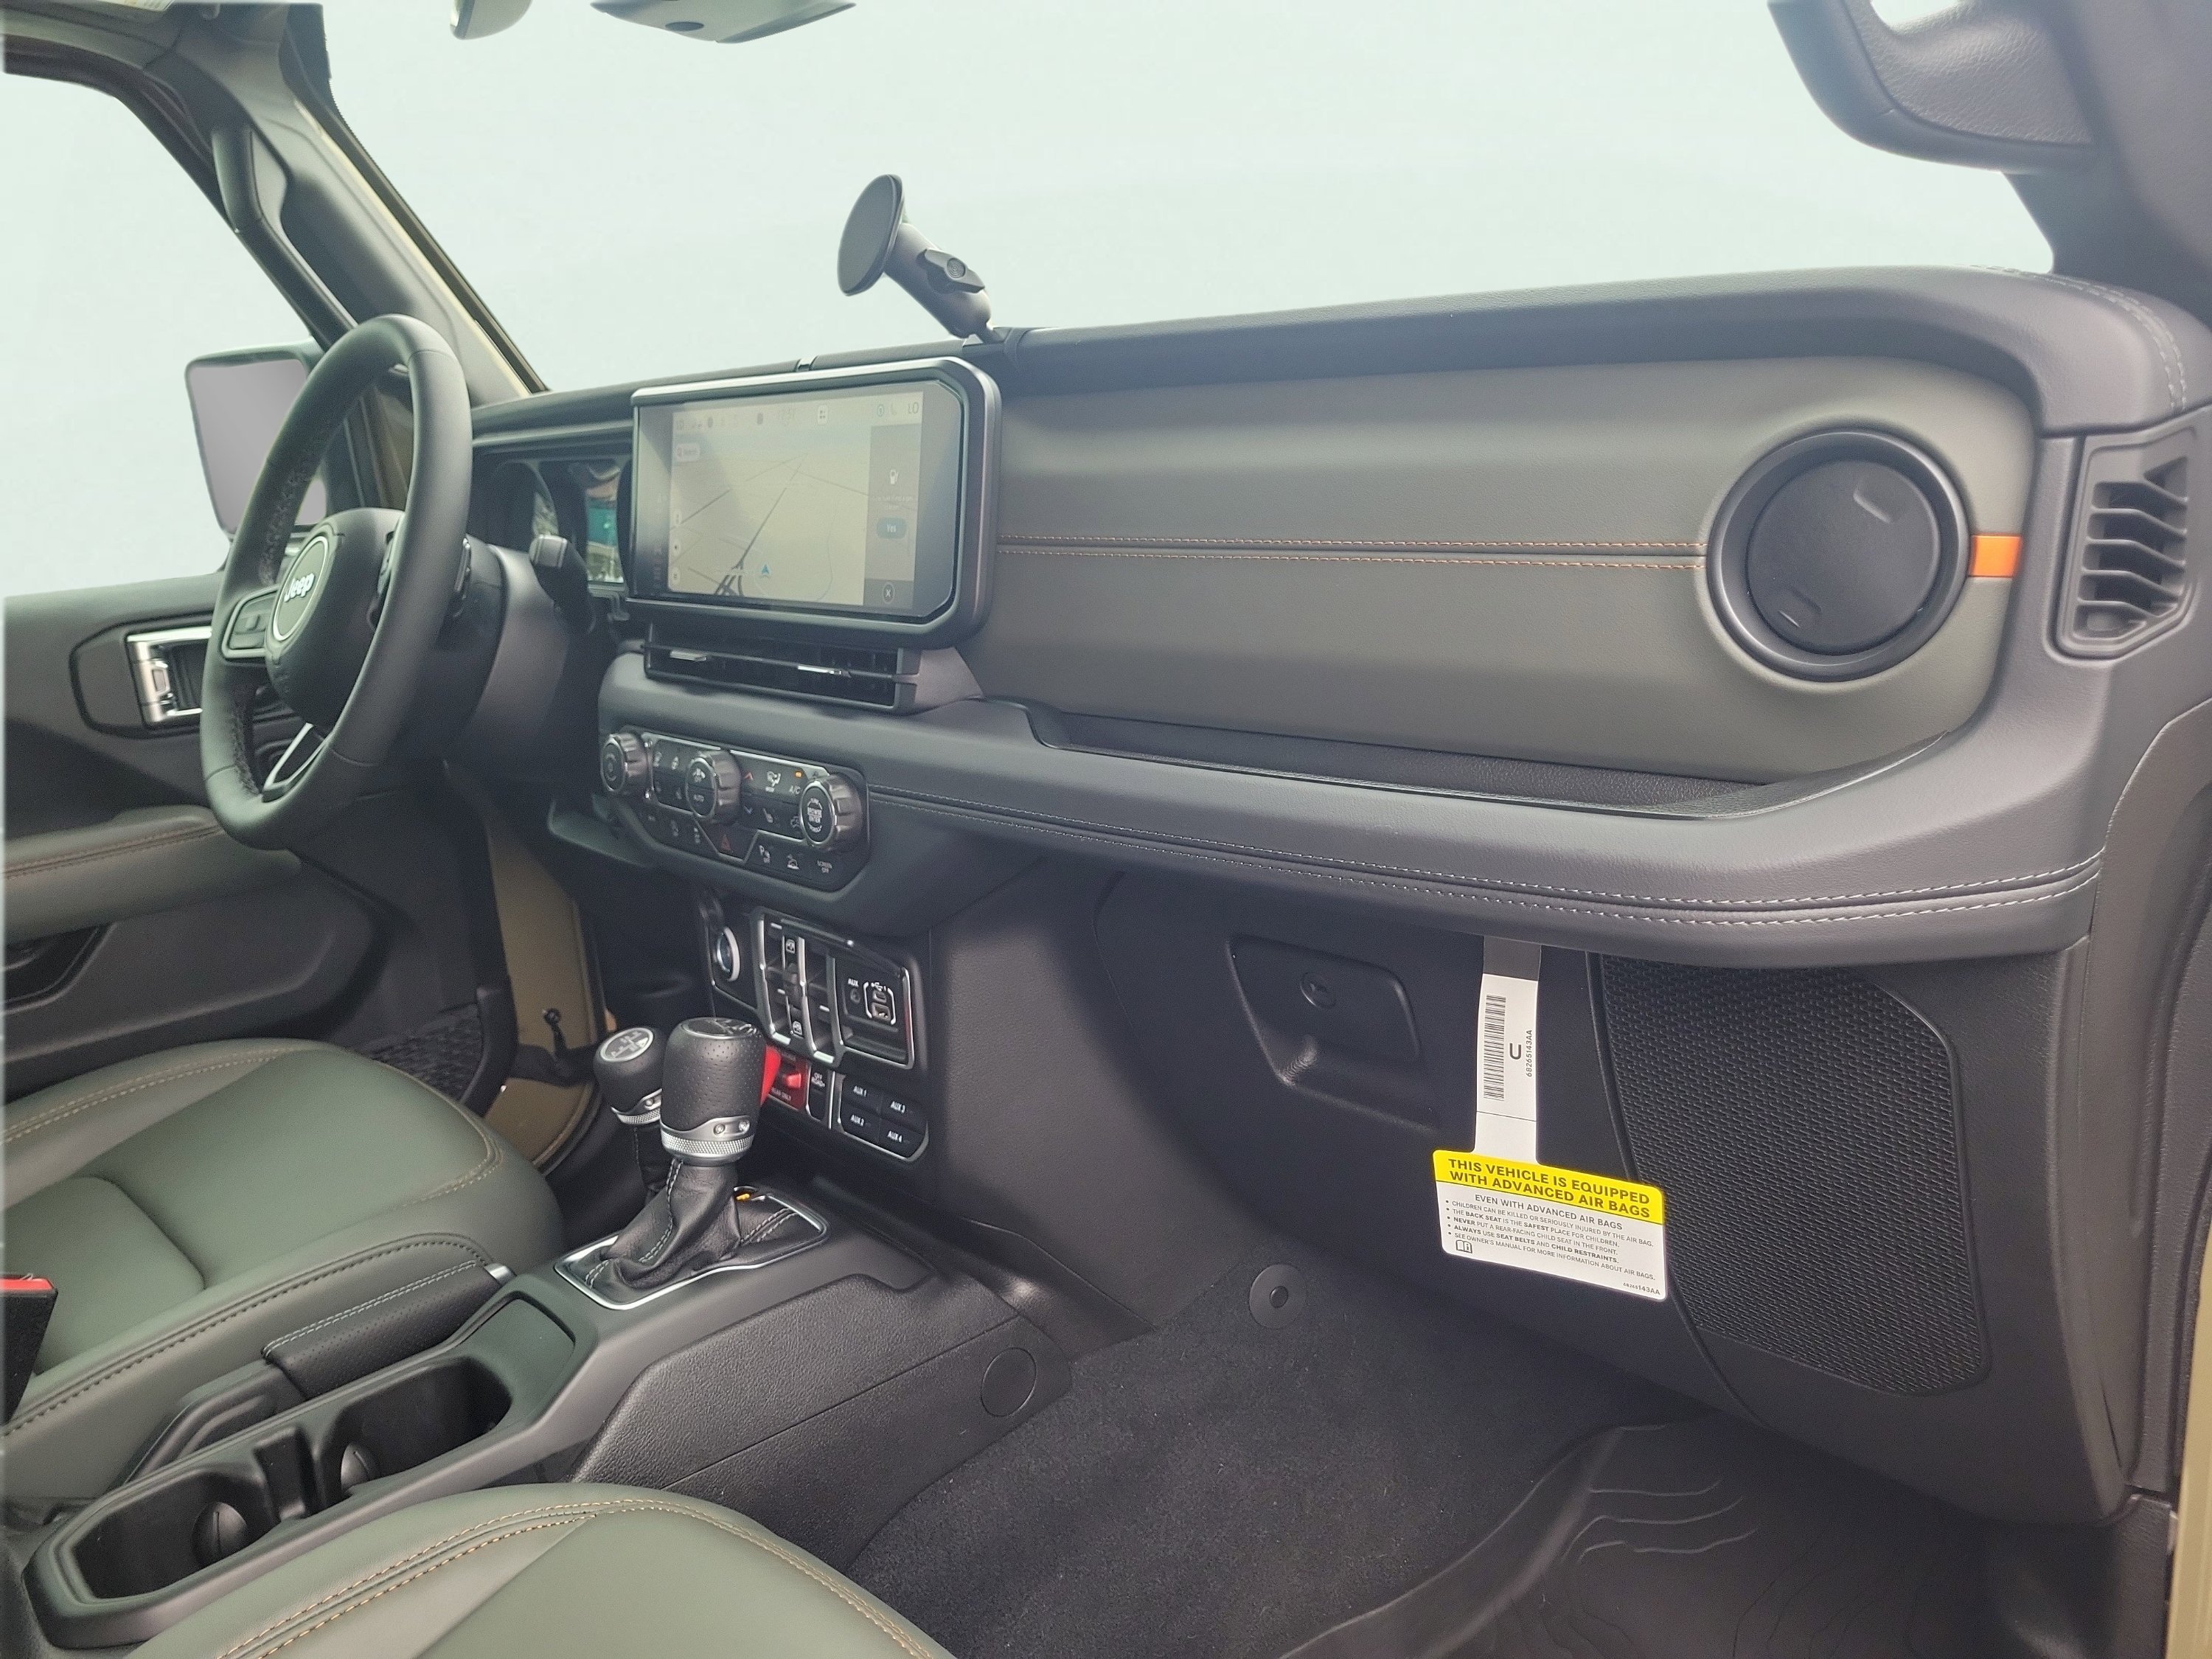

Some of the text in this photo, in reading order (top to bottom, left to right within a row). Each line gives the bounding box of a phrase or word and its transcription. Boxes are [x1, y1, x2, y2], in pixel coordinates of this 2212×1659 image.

[284, 573, 315, 602] Jeep
[848, 978, 859, 987] AUX
[1509, 1043, 1521, 1060] U
[853, 1085, 867, 1097] AUX 1
[890, 1101, 905, 1113] AUX 3
[850, 1114, 865, 1127] AUX 2
[887, 1130, 902, 1143] AUX 4
[1448, 1158, 1649, 1204] THIS VEHICLE IS EQUIPPED
[1450, 1170, 1650, 1218] WITH ADVANCED AIR BAGS
[1452, 1200, 1482, 1211] CHILDREN
[1506, 1210, 1528, 1220] KILLED
[1540, 1217, 1573, 1228] SERIOUSLY
[1575, 1224, 1601, 1235] INJURED
[1612, 1232, 1625, 1240] THE
[1638, 1239, 1654, 1248] BAG.
[1465, 1210, 1484, 1220] BACK
[1510, 1219, 1523, 1227] THE
[1523, 1222, 1549, 1231] SAFEST
[1551, 1227, 1571, 1237] PLACE
[1571, 1231, 1585, 1239] FOR
[1585, 1235, 1620, 1248] CHILDREN.
[1475, 1194, 1623, 1230] EVEN WITH ADVANCED AIR BAGS
[1453, 1217, 1475, 1225] NEVER
[1495, 1225, 1536, 1237] REAR-FACING
[1537, 1232, 1556, 1241] CHILD
[1557, 1237, 1572, 1245] SEAT
[1582, 1242, 1595, 1250] THE
[1595, 1245, 1618, 1256] FRONT.
[1454, 1225, 1481, 1235] ALWAYS
[1483, 1230, 1495, 1238] USE
[1496, 1233, 1513, 1241] SEAT
[1514, 1236, 1535, 1245] BELTS
[1551, 1243, 1573, 1253] CHILD
[1574, 1248, 1619, 1264] RESTRAINTS.
[1467, 1235, 1495, 1245] OWNER'S
[1495, 1240, 1522, 1251] MANUAL
[1537, 1249, 1555, 1257] MORE
[1557, 1252, 1600, 1267] INFORMATION
[1601, 1263, 1623, 1273] ABOUT
[1636, 1271, 1656, 1281] BAGS.
